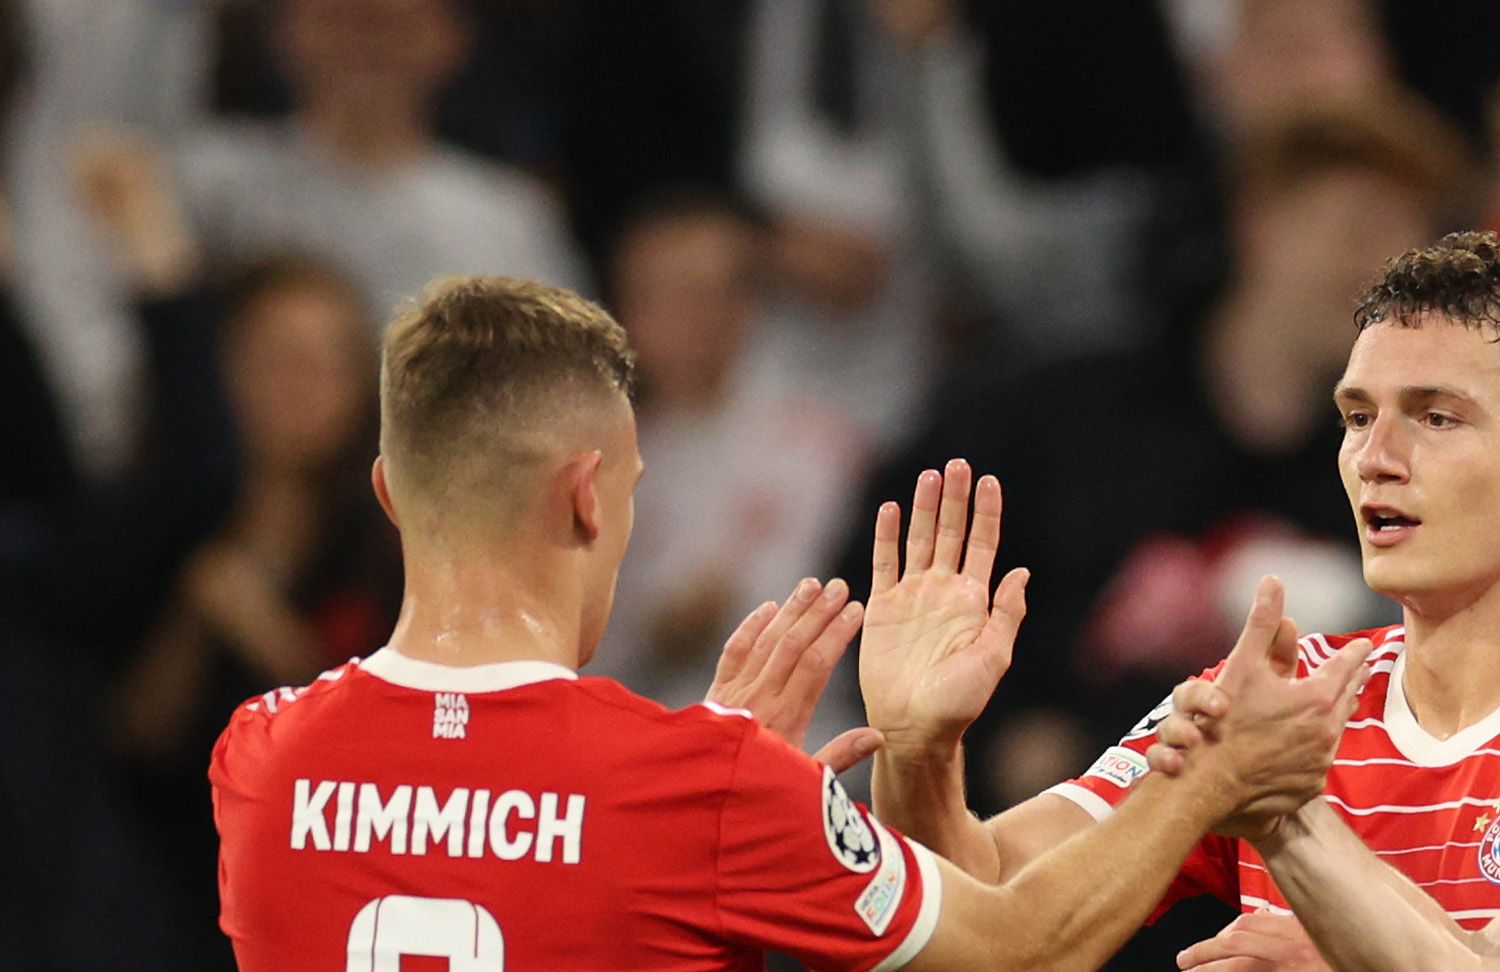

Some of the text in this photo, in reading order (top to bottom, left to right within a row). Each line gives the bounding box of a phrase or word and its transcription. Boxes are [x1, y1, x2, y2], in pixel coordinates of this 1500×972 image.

[435, 692, 468, 708] MIA
[434, 708, 469, 724] SAN
[433, 723, 466, 739] MIA
[291, 779, 585, 864] KIMMICH
